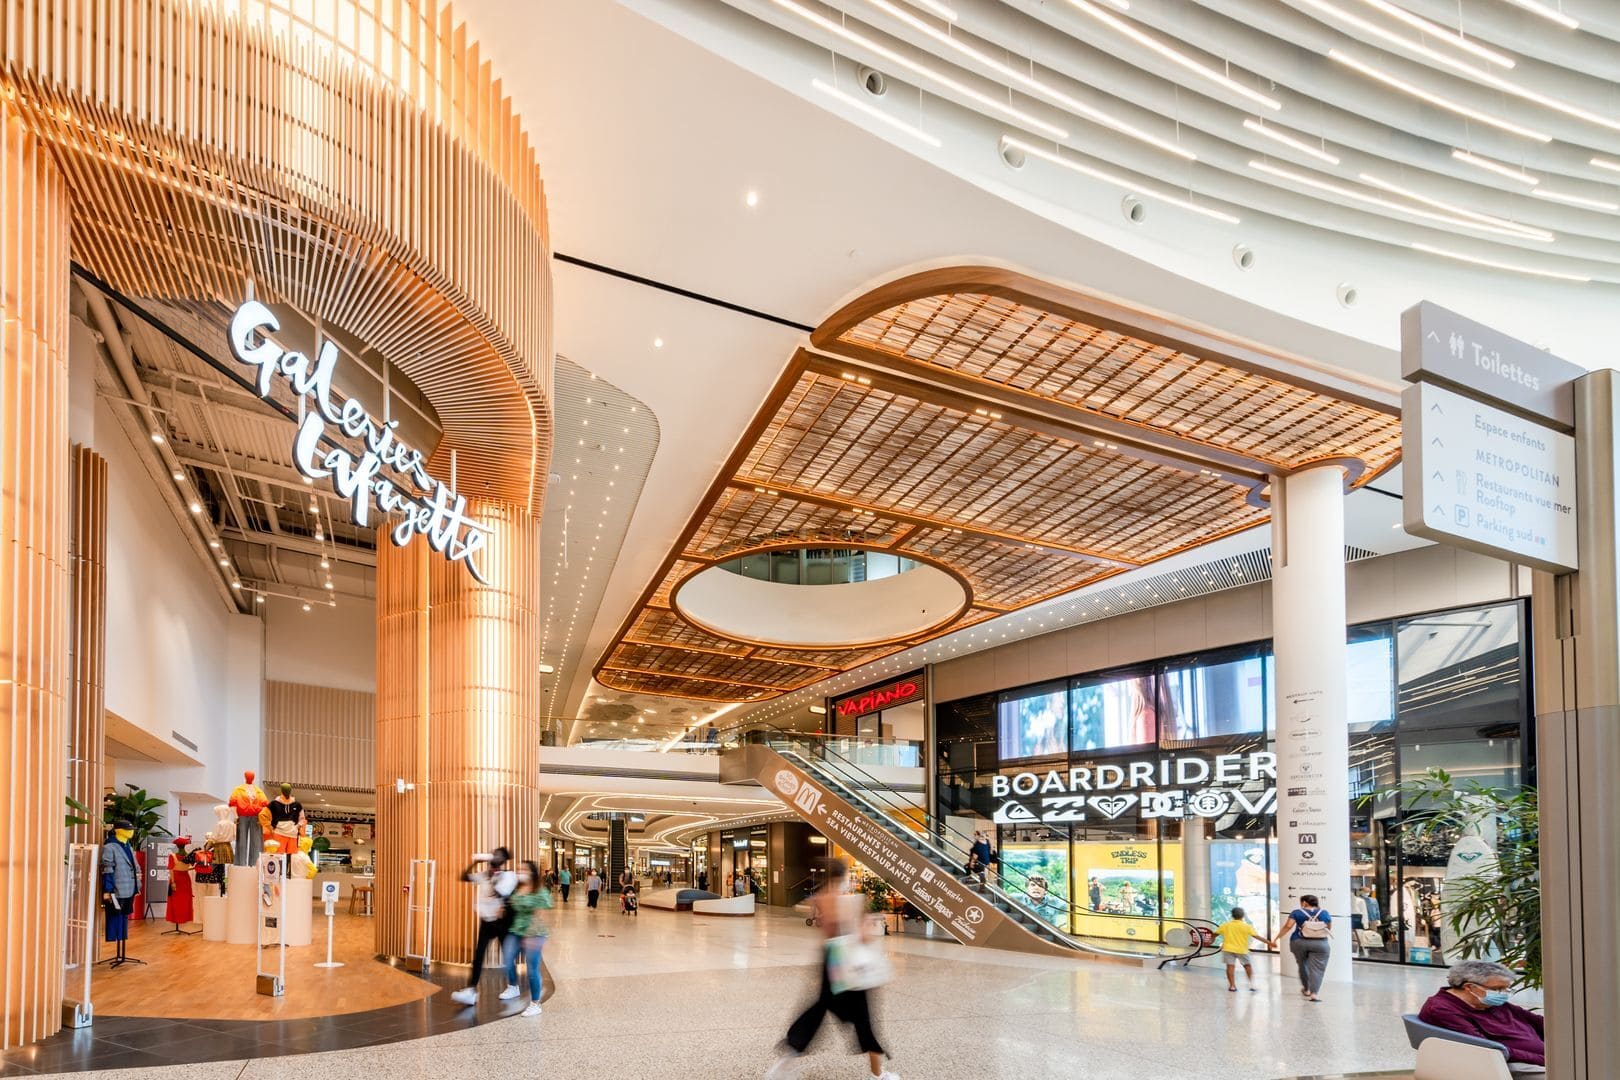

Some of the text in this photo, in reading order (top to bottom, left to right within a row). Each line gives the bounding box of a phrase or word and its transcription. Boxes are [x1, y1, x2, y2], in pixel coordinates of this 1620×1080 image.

[1471, 342, 1540, 391] Toilettes
[228, 300, 433, 491] Galeries
[1474, 414, 1546, 451] Espace enfants
[1475, 449, 1560, 488] METROPOLITAN
[293, 411, 496, 585] Lafayette
[1476, 472, 1571, 515] Restaurants vue mer
[1476, 489, 1516, 518] Rooftop
[1477, 513, 1533, 542] Parking sud
[826, 817, 839, 831] SEA
[840, 826, 859, 844] VIEW
[858, 841, 911, 885] RESTAURANTS
[831, 810, 881, 849] RESTAURANTS
[882, 845, 899, 862] VUE
[897, 859, 917, 876] MER
[934, 896, 954, 919] Tapas
